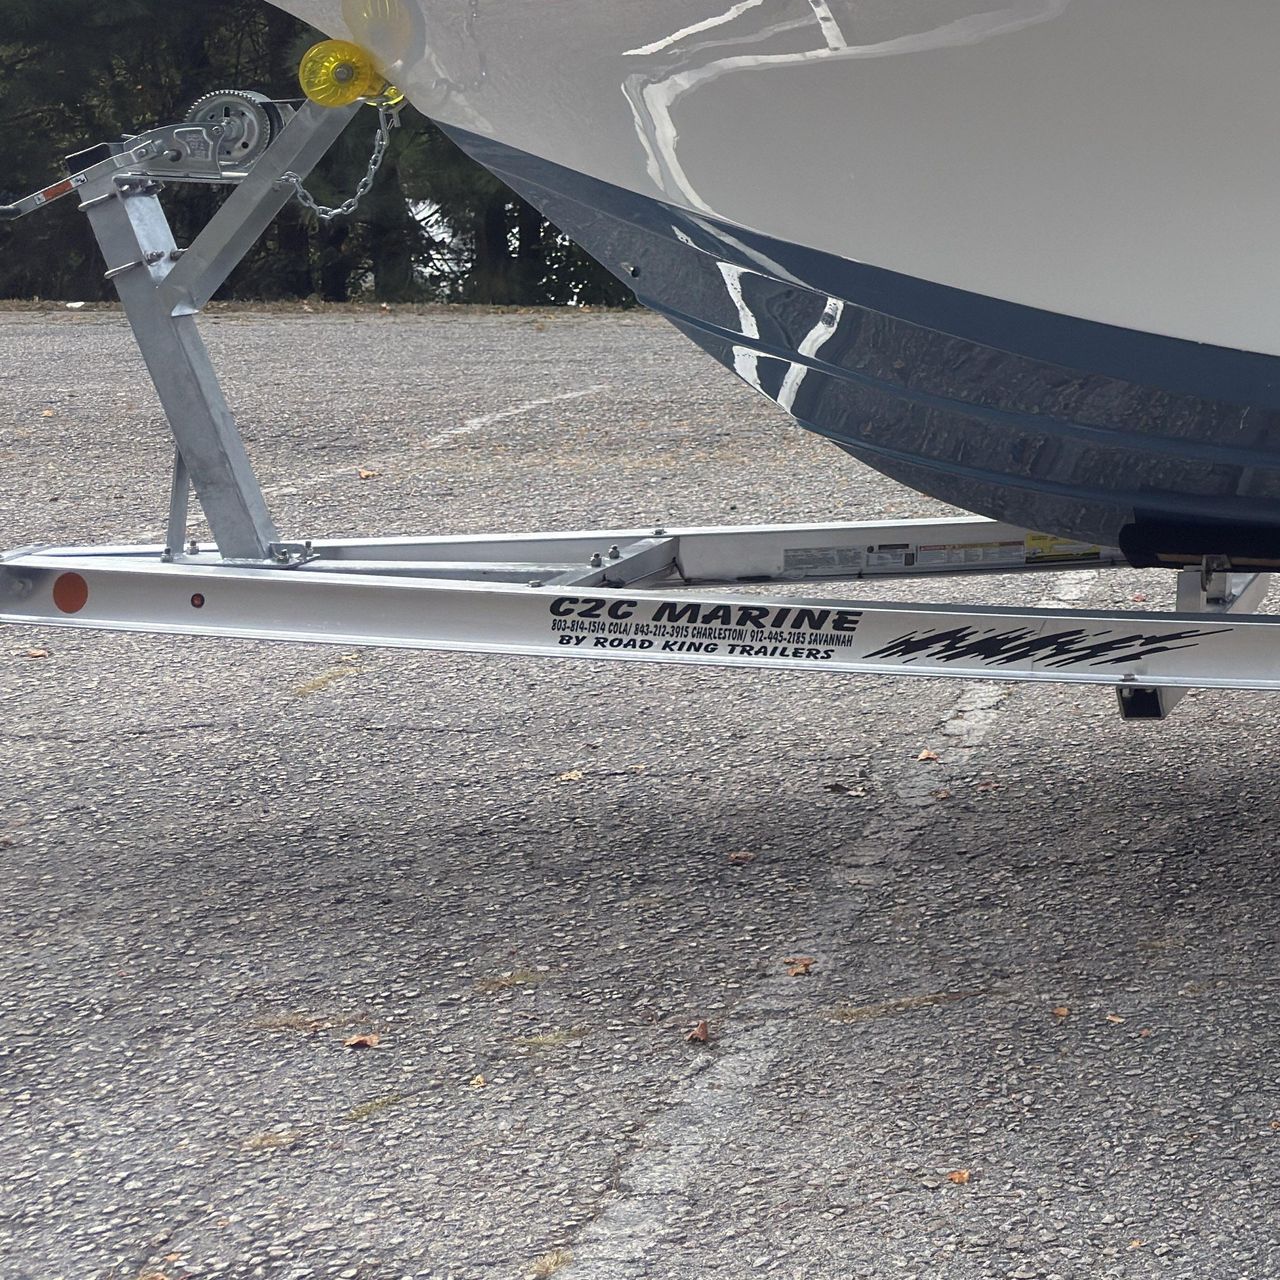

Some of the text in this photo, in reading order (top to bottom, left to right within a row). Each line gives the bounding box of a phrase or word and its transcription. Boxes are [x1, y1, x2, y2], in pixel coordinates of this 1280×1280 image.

[550, 597, 863, 631] C2C MARINE
[551, 619, 854, 647] 803-814-1514 COLA/ 843-212-3915 CHARLESTON/ 912-445-2185 SAVANNAH
[558, 634, 835, 660] BY ROAD KING TRAILERS
